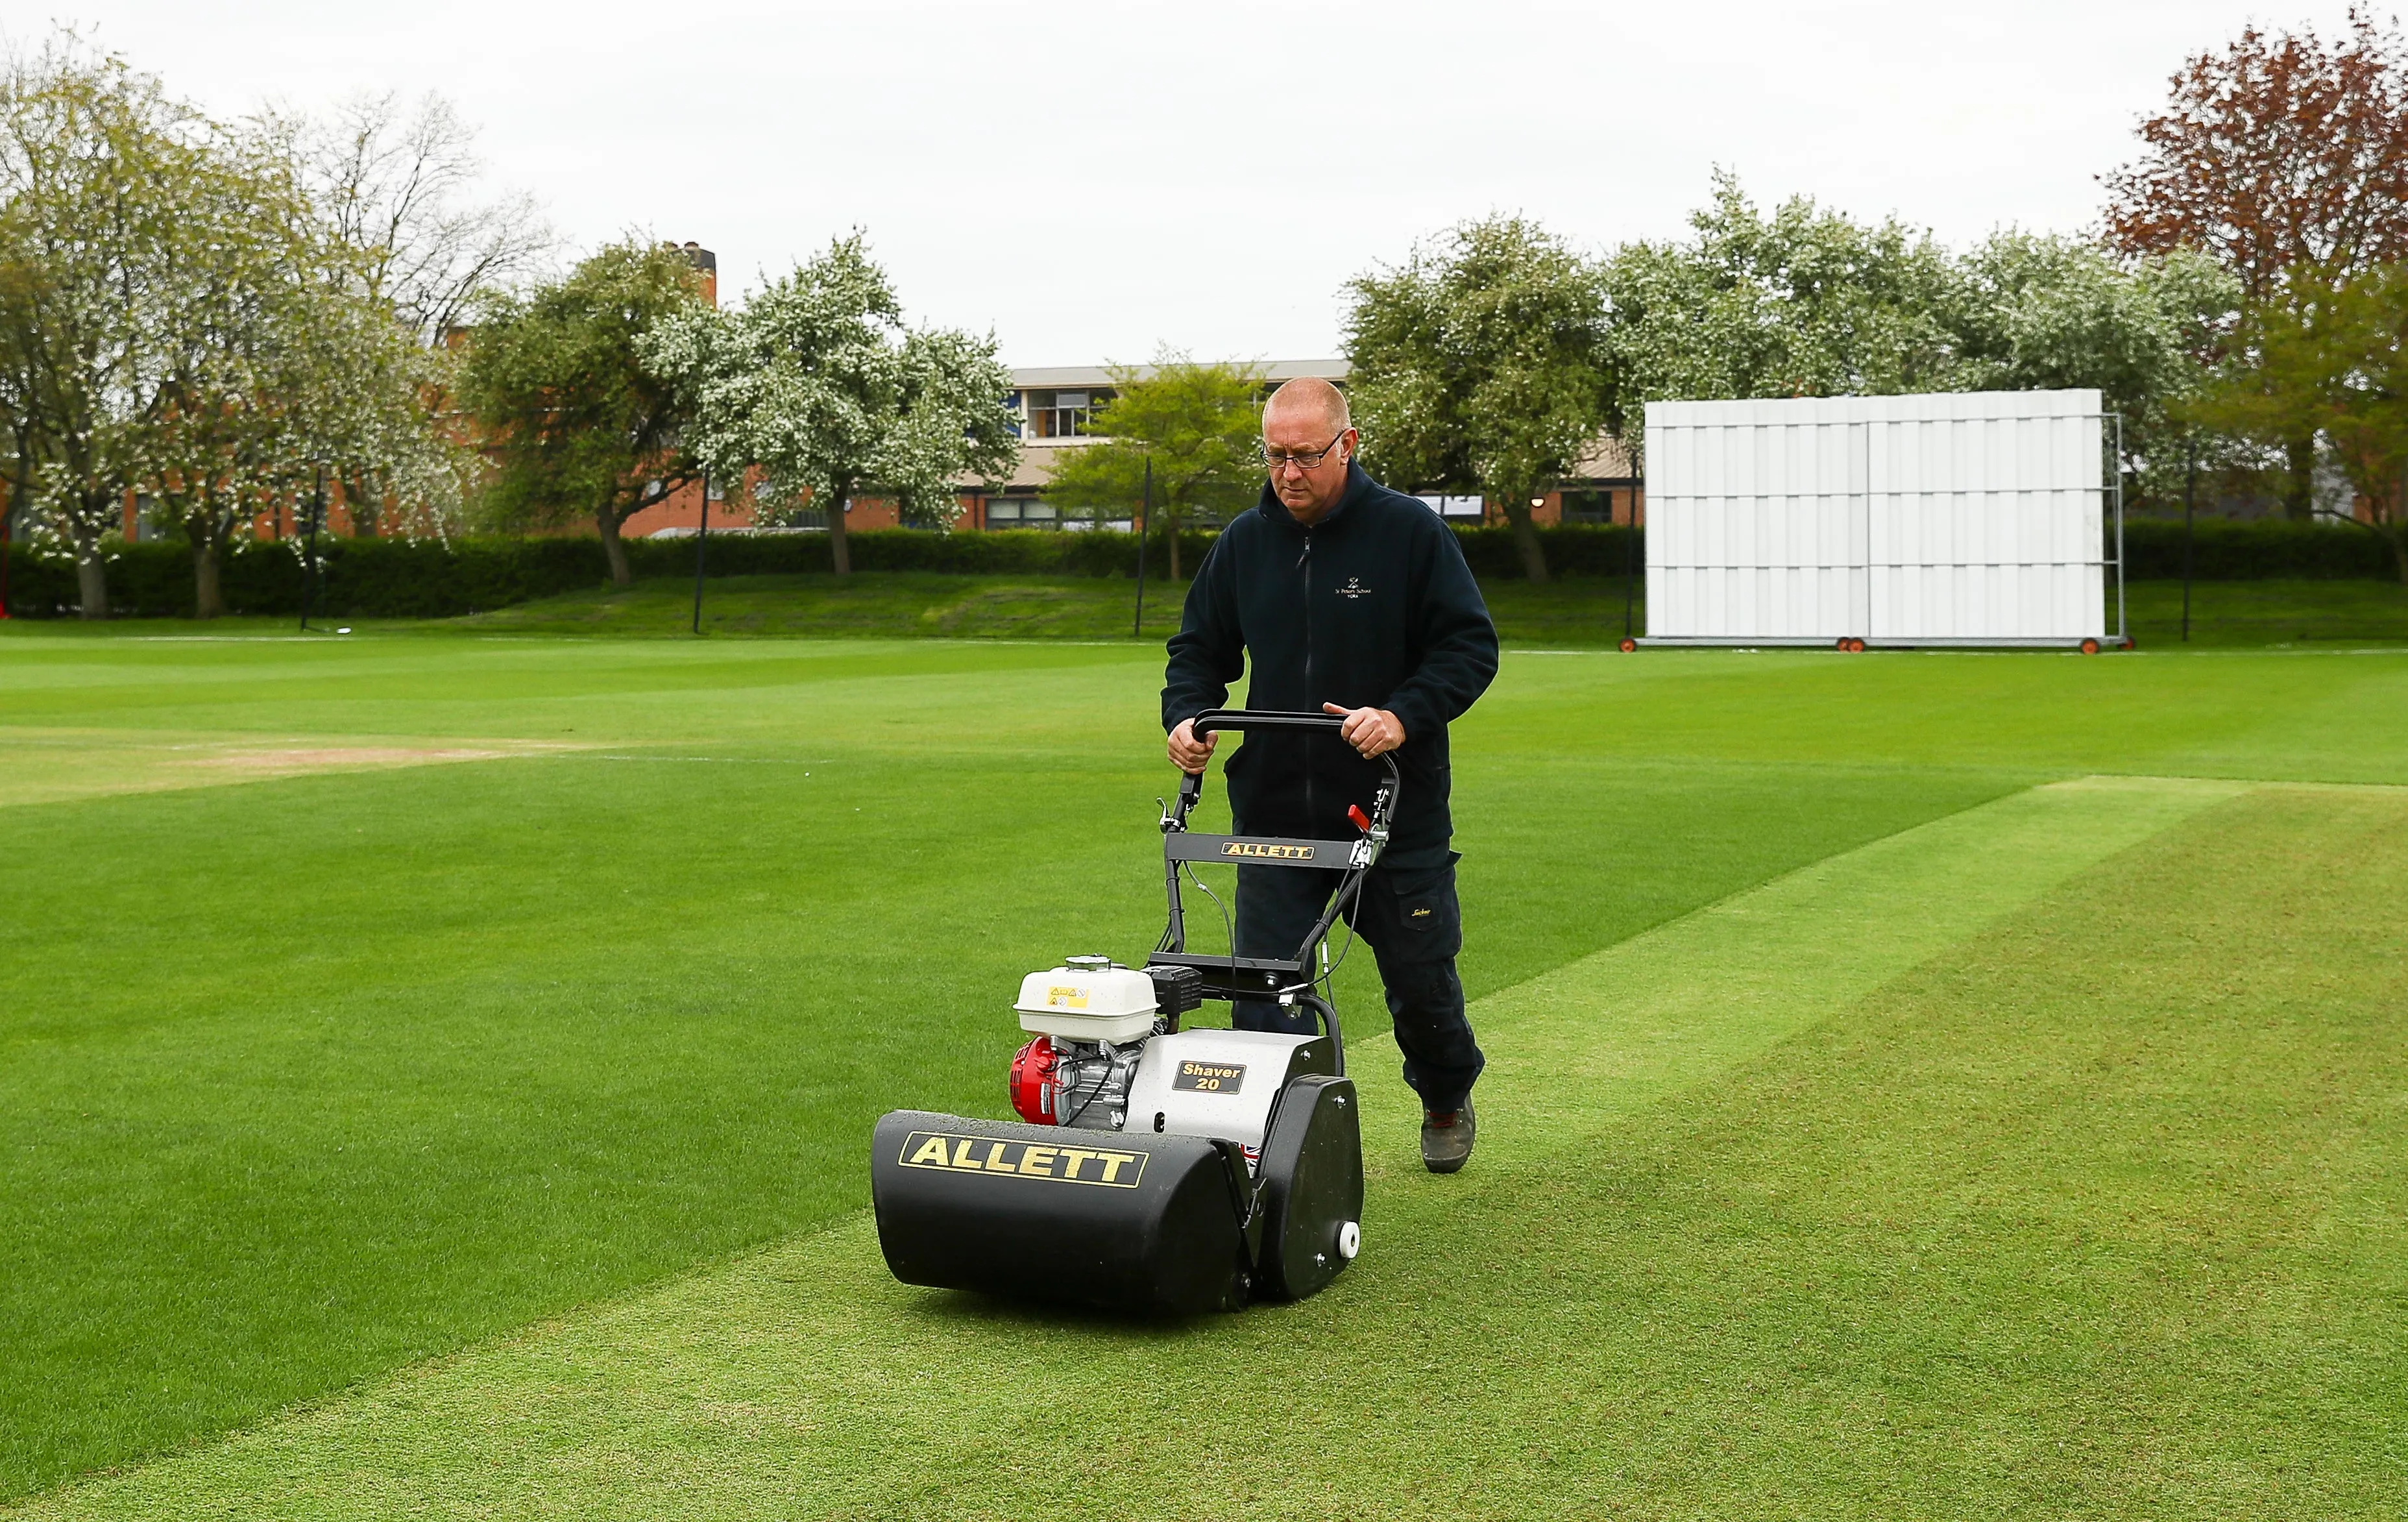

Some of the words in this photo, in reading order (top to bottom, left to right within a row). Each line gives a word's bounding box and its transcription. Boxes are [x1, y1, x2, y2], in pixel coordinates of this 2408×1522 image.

[1228, 843, 1308, 857] ALLETT
[1182, 1063, 1241, 1079] Shaver
[1195, 1077, 1220, 1090] 20
[910, 1136, 1135, 1183] ALLETT
